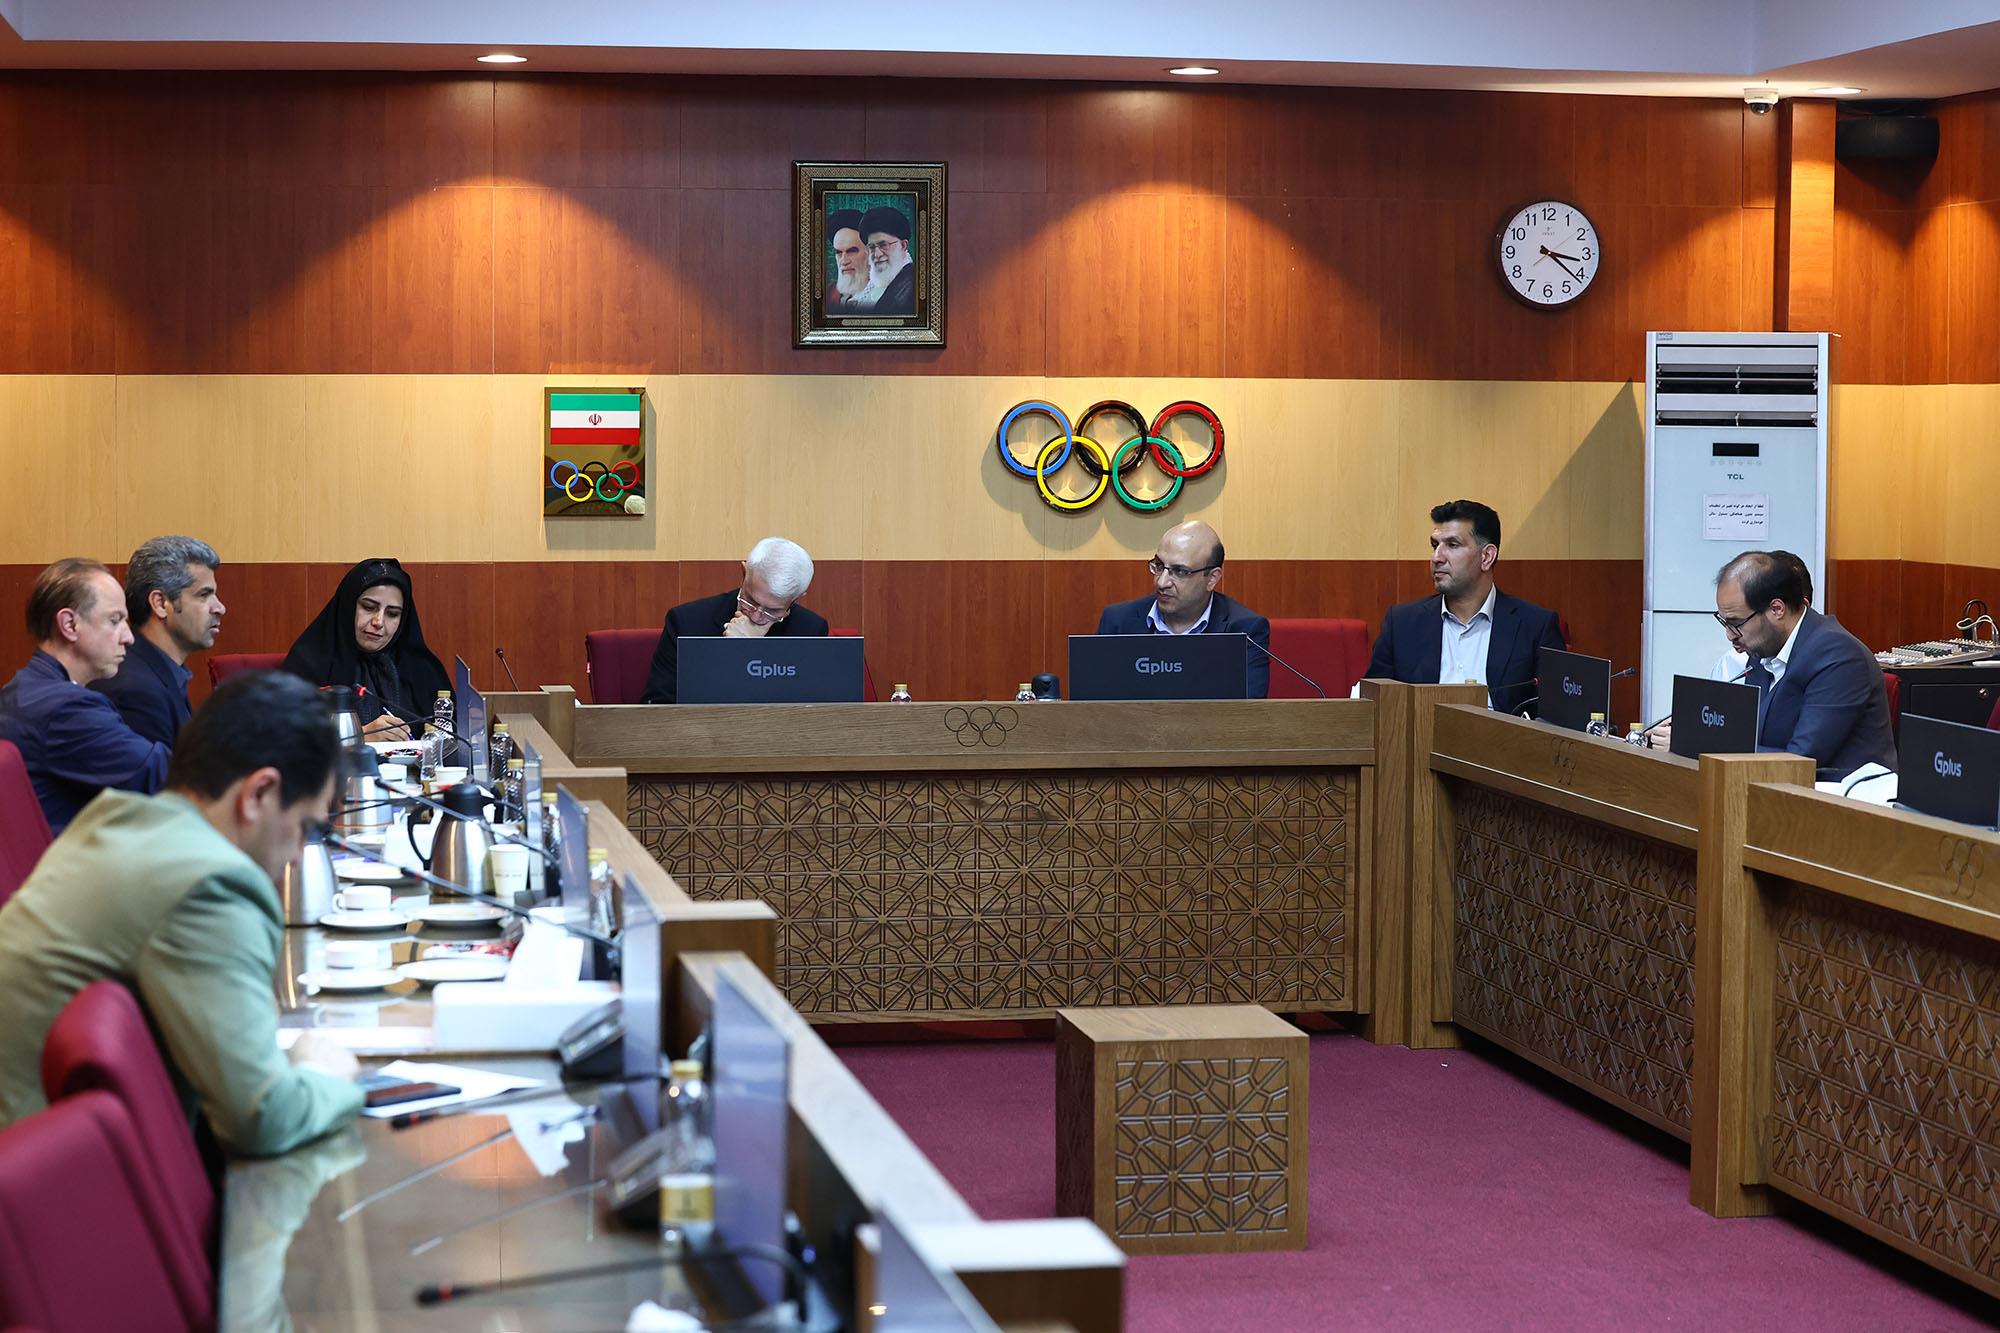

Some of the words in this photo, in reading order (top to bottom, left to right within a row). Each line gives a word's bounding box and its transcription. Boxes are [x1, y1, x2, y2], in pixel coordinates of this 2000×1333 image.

[1525, 213, 1537, 226] 11
[1542, 208, 1556, 221] 12
[1565, 214, 1570, 226] 1
[1511, 228, 1526, 240] 10
[1577, 228, 1586, 240] 2
[1505, 245, 1515, 259] 9
[1581, 247, 1591, 260] 3
[1512, 265, 1522, 278] 8
[1576, 267, 1585, 279] 4
[1526, 279, 1535, 292] 7
[1543, 284, 1553, 297] 6
[1562, 281, 1571, 293] 5
[747, 659, 796, 679] Gplus
[1135, 657, 1183, 676] Gplus
[1563, 676, 1582, 696] Gplus
[1701, 705, 1725, 728] Gplus
[1934, 751, 1962, 777] Gplus
